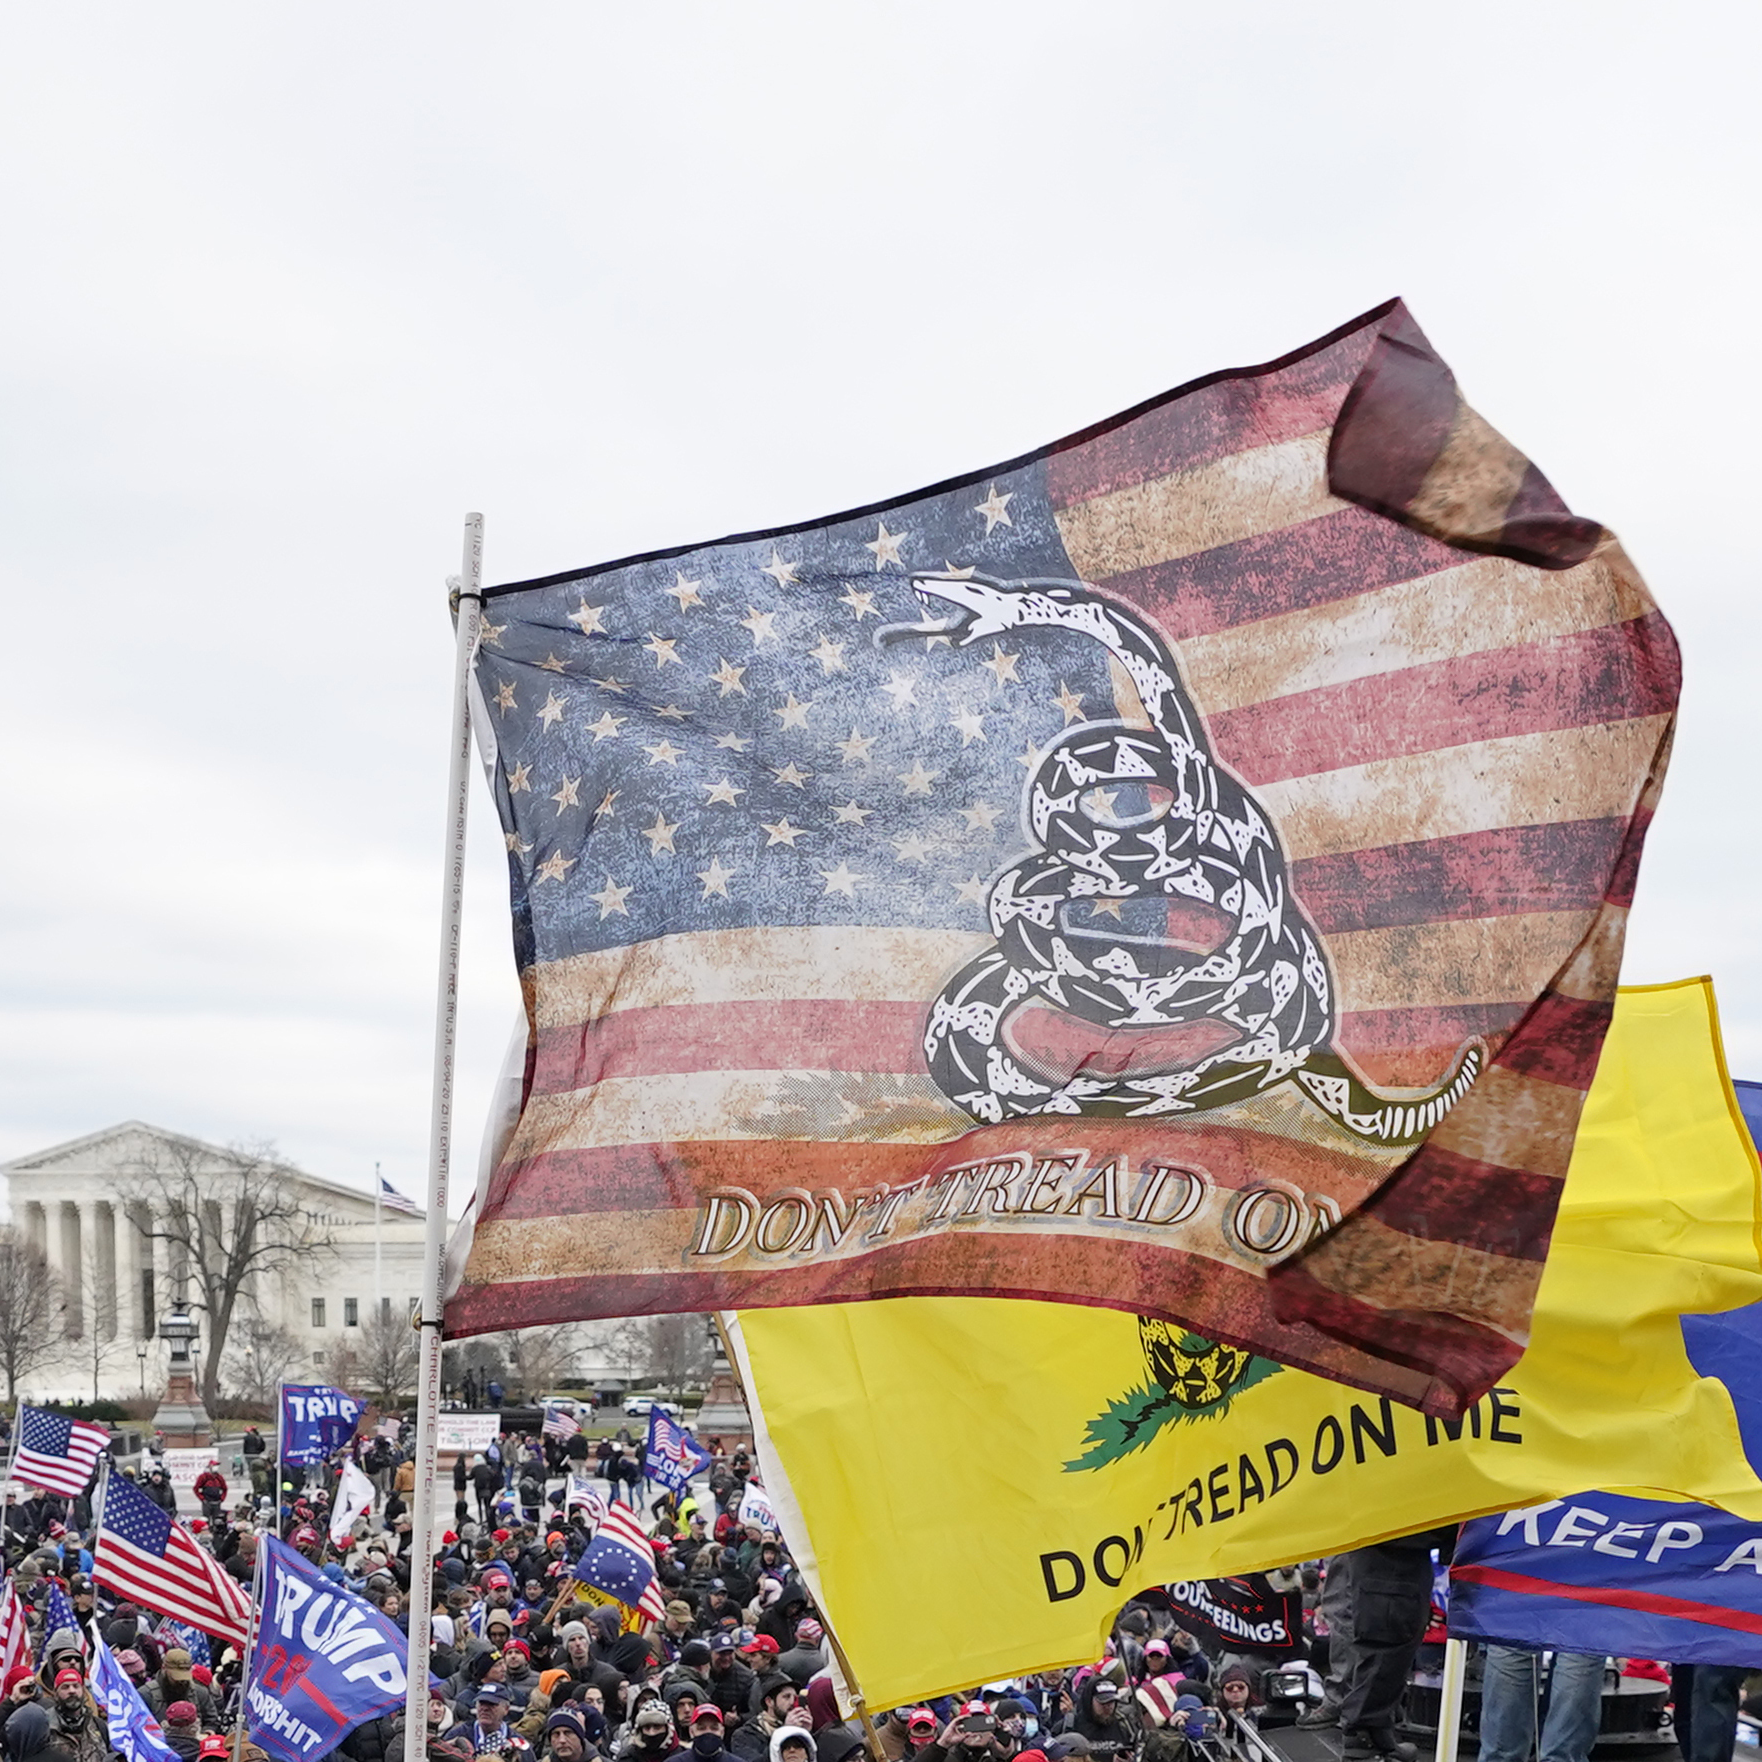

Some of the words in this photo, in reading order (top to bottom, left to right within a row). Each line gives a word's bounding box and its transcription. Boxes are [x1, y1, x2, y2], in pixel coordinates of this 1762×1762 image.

[688, 1175, 928, 1263] DON'T
[925, 1149, 1212, 1229] TREAD
[1163, 1438, 1300, 1541] TREAD
[1311, 1397, 1399, 1475] ON
[1496, 1497, 1703, 1564] KEEP
[275, 1563, 408, 1695] TRUMP
